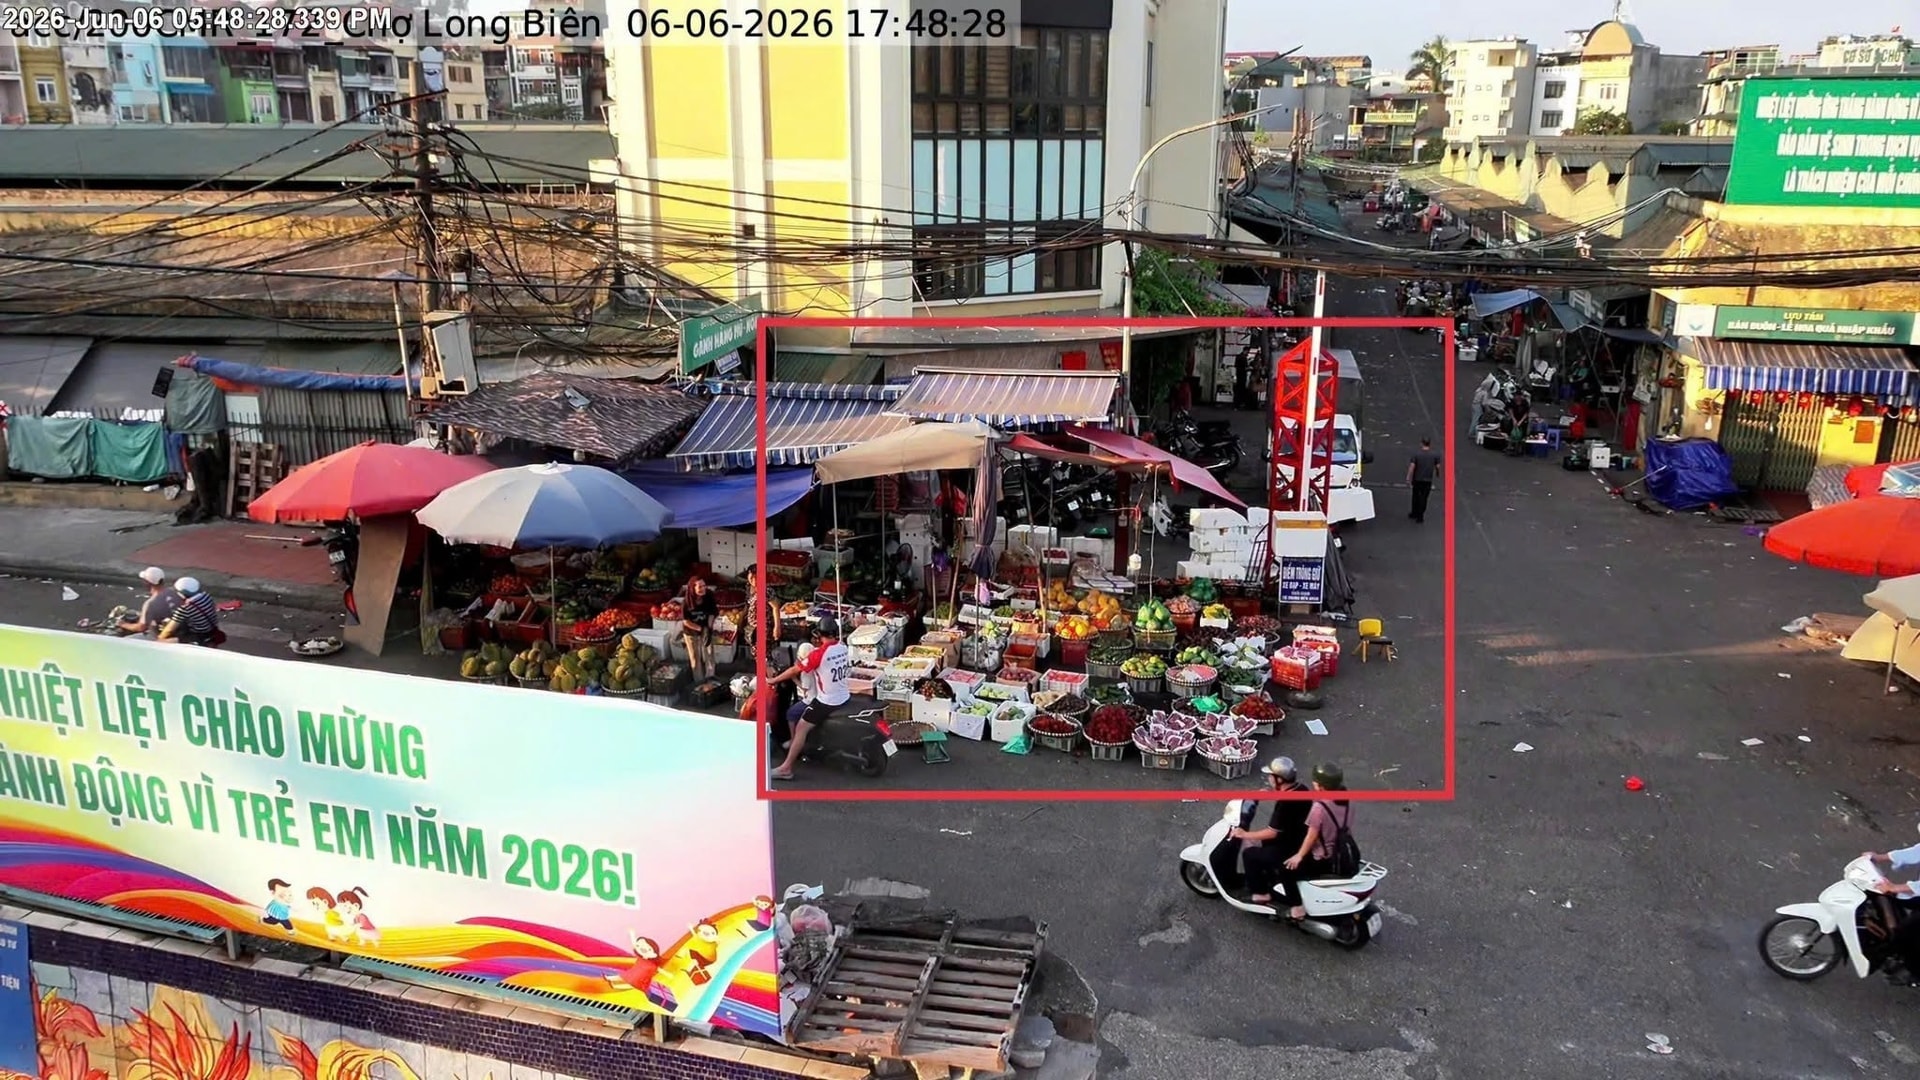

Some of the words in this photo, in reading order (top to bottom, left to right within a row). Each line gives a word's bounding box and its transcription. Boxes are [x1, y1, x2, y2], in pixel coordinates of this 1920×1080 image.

[95, 674, 167, 749] LIỆT
[181, 687, 286, 759] CHÀO
[297, 705, 427, 780] MỪNG
[73, 756, 173, 827] ĐỘNG
[180, 772, 220, 833] VÌ
[228, 779, 300, 848] TRẺ
[309, 801, 375, 860] EM
[386, 805, 488, 880] NĂM
[502, 833, 636, 905] 2026!
